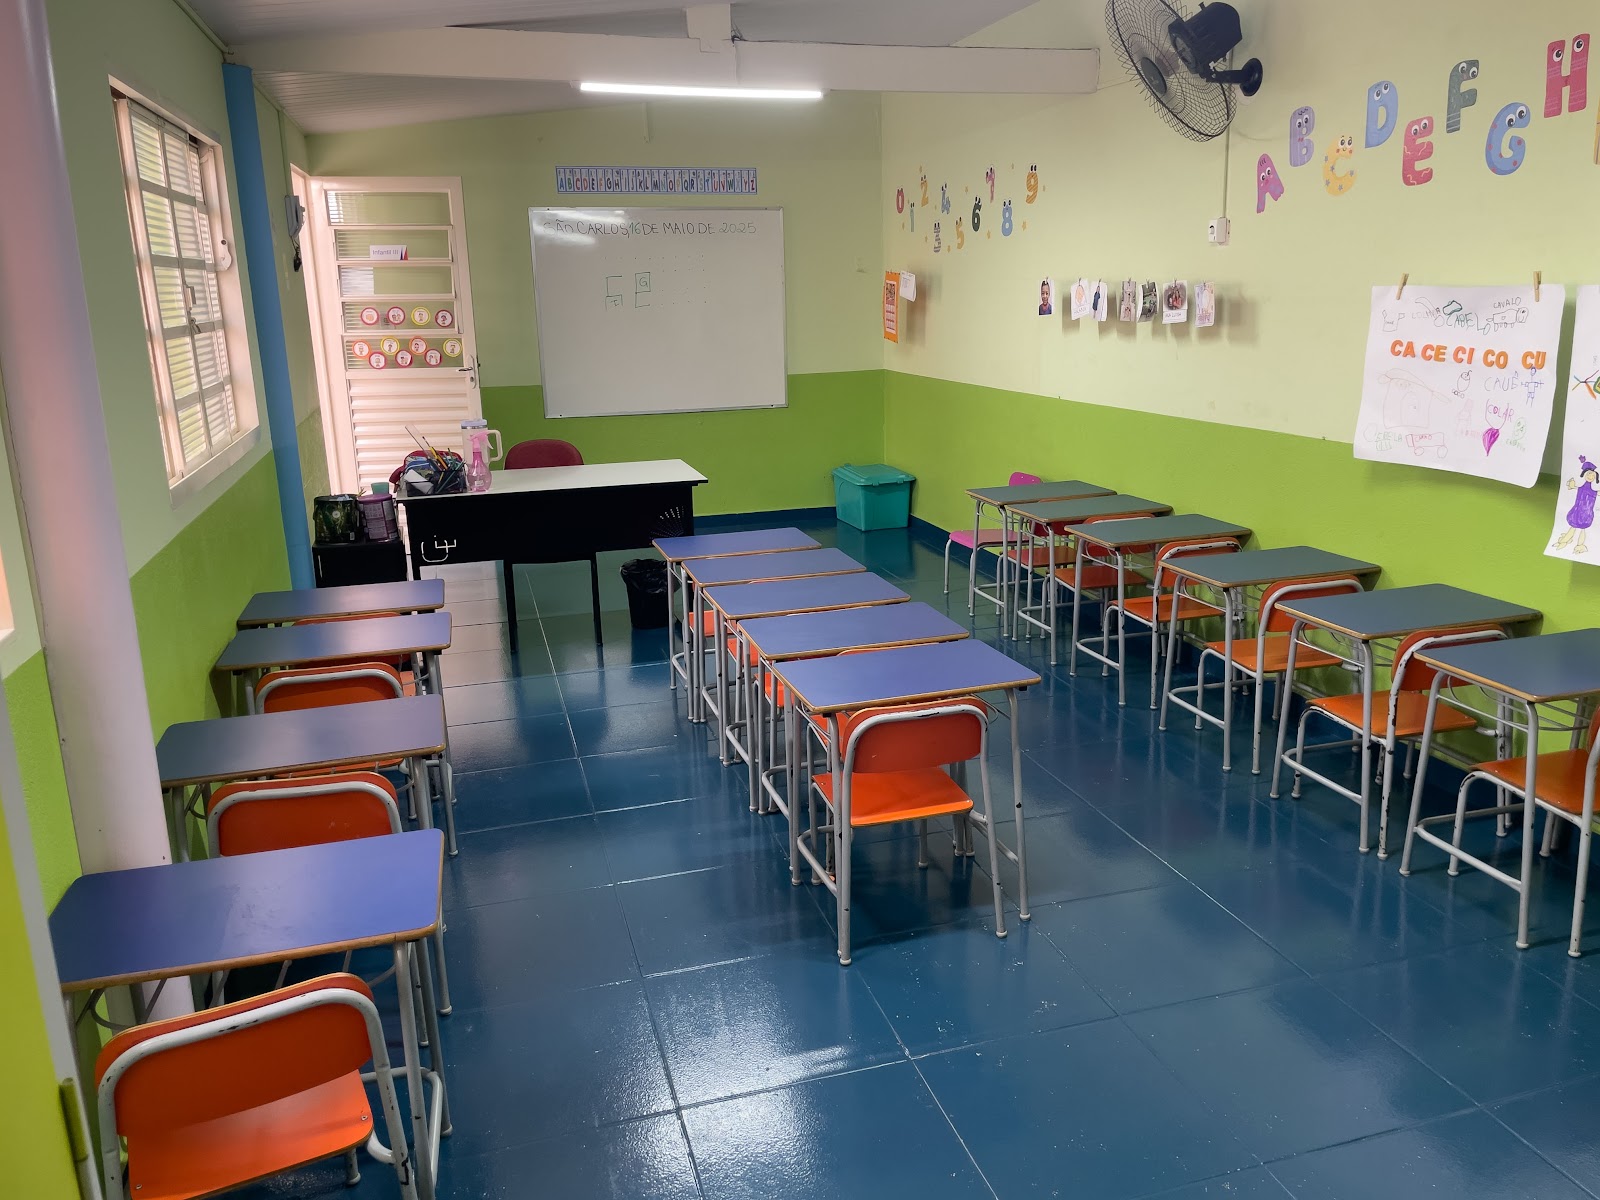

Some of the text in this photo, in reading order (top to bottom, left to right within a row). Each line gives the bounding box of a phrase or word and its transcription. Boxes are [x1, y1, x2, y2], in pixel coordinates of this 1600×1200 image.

[1256, 153, 1285, 214] A
[1289, 106, 1315, 167] B
[1322, 135, 1357, 197] C
[1365, 80, 1398, 149] D
[1402, 115, 1434, 187] E
[1446, 59, 1479, 133] F
[1485, 101, 1531, 176] G
[1543, 33, 1590, 118] H
[896, 163, 1039, 253] 0 1 2 3 4 5 6 7 8 9
[543, 219, 574, 235] SÃO
[642, 223, 659, 235] DE
[663, 222, 694, 235] MAIO
[698, 222, 715, 235] DE
[719, 222, 756, 234] 2025
[1493, 297, 1521, 309] CAVALO
[1390, 339, 1547, 370] CA CE CI CO CU
[1488, 404, 1515, 422] COLAR
